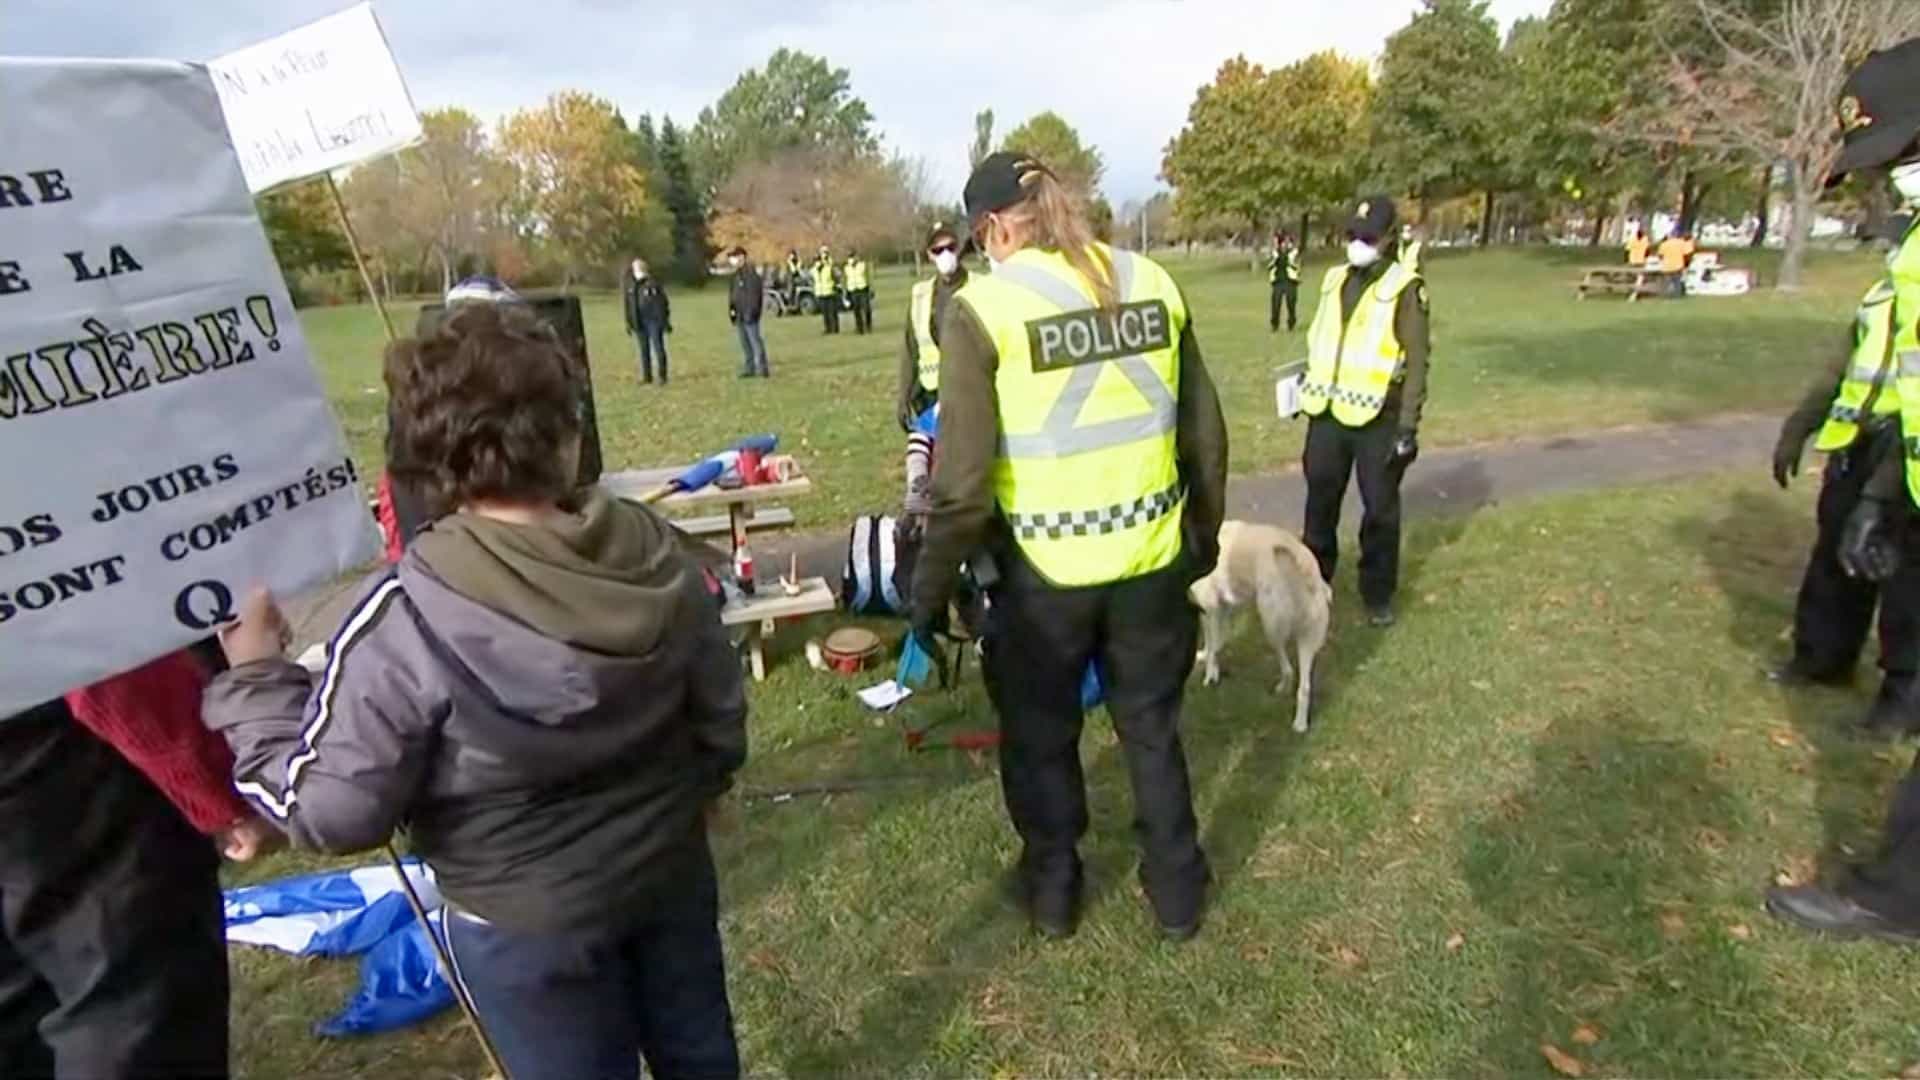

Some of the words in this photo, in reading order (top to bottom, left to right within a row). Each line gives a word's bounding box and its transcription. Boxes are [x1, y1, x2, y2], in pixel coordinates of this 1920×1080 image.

[0, 169, 73, 207] RE
[0, 261, 31, 295] E
[64, 244, 143, 282] LA
[1039, 304, 1163, 364] POLICE
[92, 454, 240, 523] JOURS
[160, 458, 358, 561] COMPTÉS!
[174, 579, 240, 630] Q
